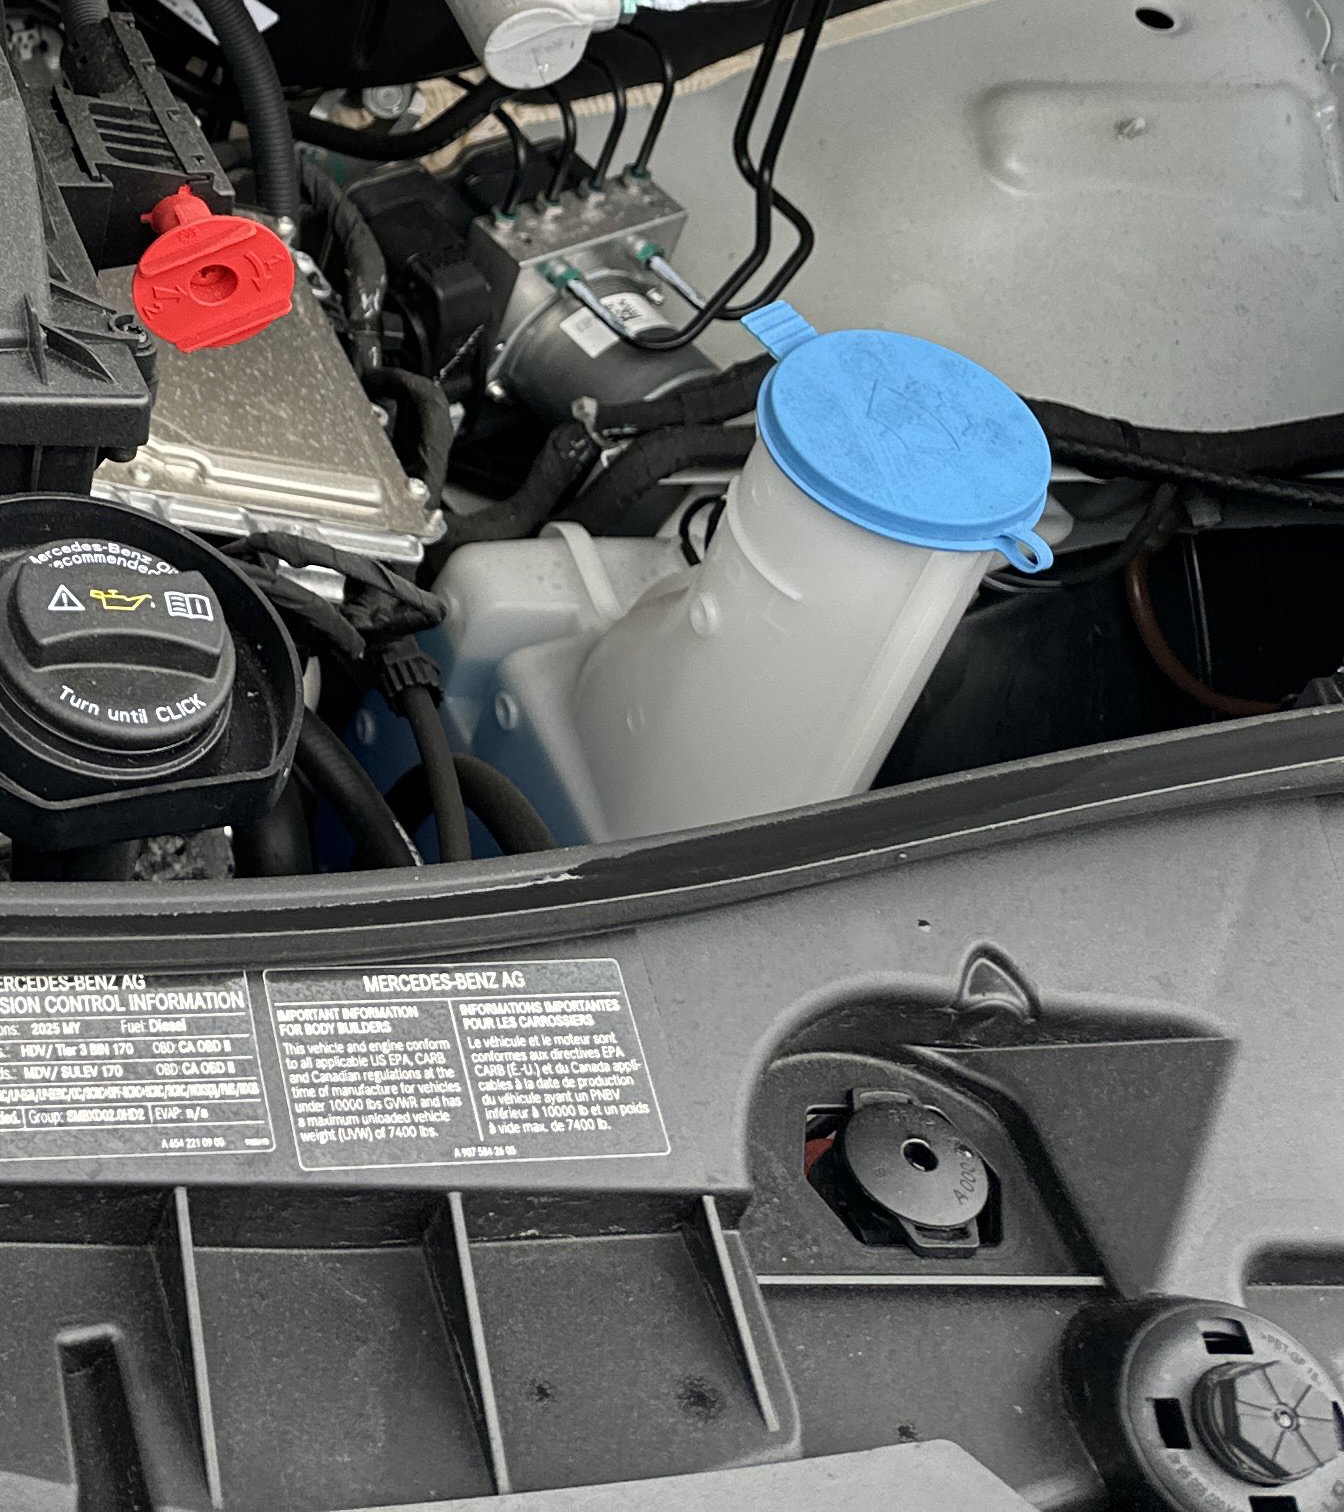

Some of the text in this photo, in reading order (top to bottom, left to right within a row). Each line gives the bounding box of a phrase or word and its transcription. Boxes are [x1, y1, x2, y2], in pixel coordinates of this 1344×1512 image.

[48, 553, 161, 576] ecommende
[59, 684, 207, 724] Turn until CLICK
[121, 973, 147, 991] AG
[362, 970, 525, 992] MERCEDES-BENZ AG
[44, 994, 126, 1013] CONTROL
[127, 991, 245, 1011] INFORMATION
[459, 998, 621, 1016] INFORMATIONS IMPORTANTES
[276, 1005, 419, 1022] IMPORTANT INFORMATION
[462, 1013, 595, 1030] POUR LES CARROSSIERS
[30, 1022, 60, 1035] 2025
[61, 1021, 80, 1034] MY
[148, 1017, 186, 1032] Diesel
[278, 1020, 392, 1036] FOR BODY BUILDERS
[20, 1043, 53, 1059] HDV/
[54, 1043, 77, 1056] Tier
[78, 1043, 87, 1056] 3
[88, 1042, 110, 1055] BIN
[112, 1042, 134, 1055] 170
[177, 1040, 196, 1053] CA
[196, 1039, 221, 1052] OBD
[282, 1037, 450, 1057] This vehicle and engine conform
[285, 1051, 446, 1070] to all applicable US EPA, CARB
[23, 1065, 58, 1080] MDV/
[60, 1064, 98, 1078] SULEV
[101, 1064, 123, 1077] 170
[181, 1061, 200, 1075] CA
[200, 1061, 226, 1074] OBD
[288, 1066, 455, 1084] and Canadian regulations at the
[290, 1080, 461, 1098] time of manufacture for vehicles
[294, 1095, 462, 1113] under 10000 lbs GVWR and has
[28, 1109, 64, 1125] Group:
[297, 1109, 450, 1127] a maximum unloaded vehicle
[299, 1125, 438, 1144] weight (UVW) of 7400 lbs.
[454, 1147, 461, 1157] A
